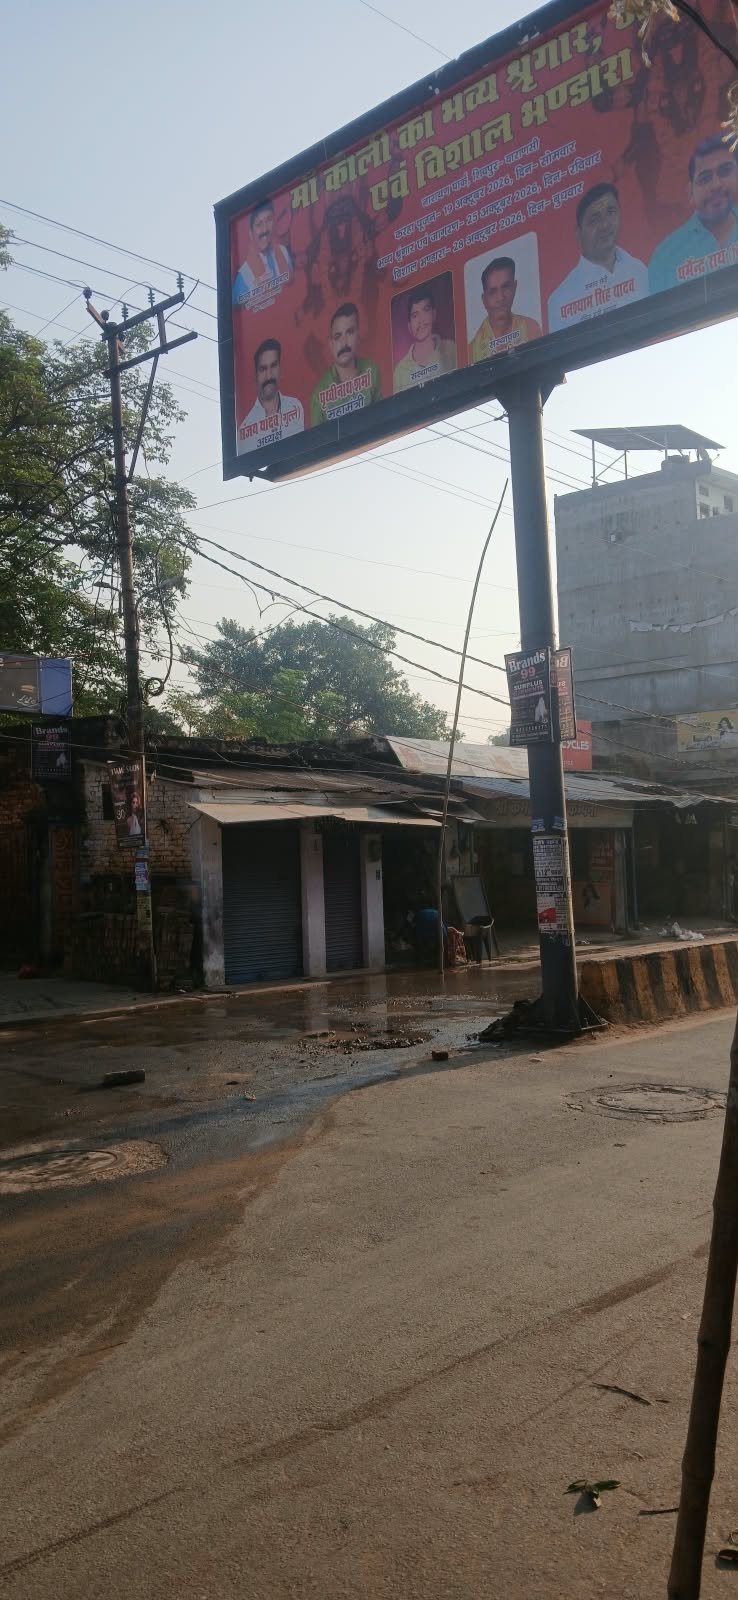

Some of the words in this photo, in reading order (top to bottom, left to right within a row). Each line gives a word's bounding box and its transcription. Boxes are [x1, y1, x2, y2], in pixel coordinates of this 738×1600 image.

[290, 169, 319, 209] माँ
[323, 129, 392, 192] काली
[397, 110, 434, 149] का
[441, 73, 499, 123] भव्य
[370, 160, 409, 211] एवं
[415, 112, 513, 189] विशाल
[521, 48, 634, 128] भण्डारा
[421, 185, 451, 207] नारायण
[504, 136, 540, 164] वाराणसी
[442, 203, 454, 216] 19
[455, 186, 486, 209] अक्टूबर
[487, 174, 513, 193] 2026,
[539, 139, 577, 167] सोमवार
[377, 252, 394, 269] भव्य
[416, 232, 429, 250] एवं
[466, 210, 479, 225] 25
[480, 194, 513, 218] अक्टूबर
[513, 183, 542, 203] 2026,
[568, 150, 602, 175] रविवार
[393, 260, 418, 280] विशाल
[452, 238, 464, 253] 28
[465, 221, 497, 244] अक्टूबर
[499, 210, 526, 230] 2026,
[552, 181, 585, 209] बुधवार
[594, 285, 611, 307] सिंह
[613, 278, 635, 297] यादव
[353, 368, 372, 393] शर्मा
[326, 392, 365, 420] महामंत्री
[260, 414, 279, 432] यादव
[256, 430, 282, 448] अध्यक्ष
[508, 651, 546, 673] Brands
[520, 667, 536, 680] 99
[514, 680, 543, 691] SURPLUS
[35, 726, 68, 735] Brands
